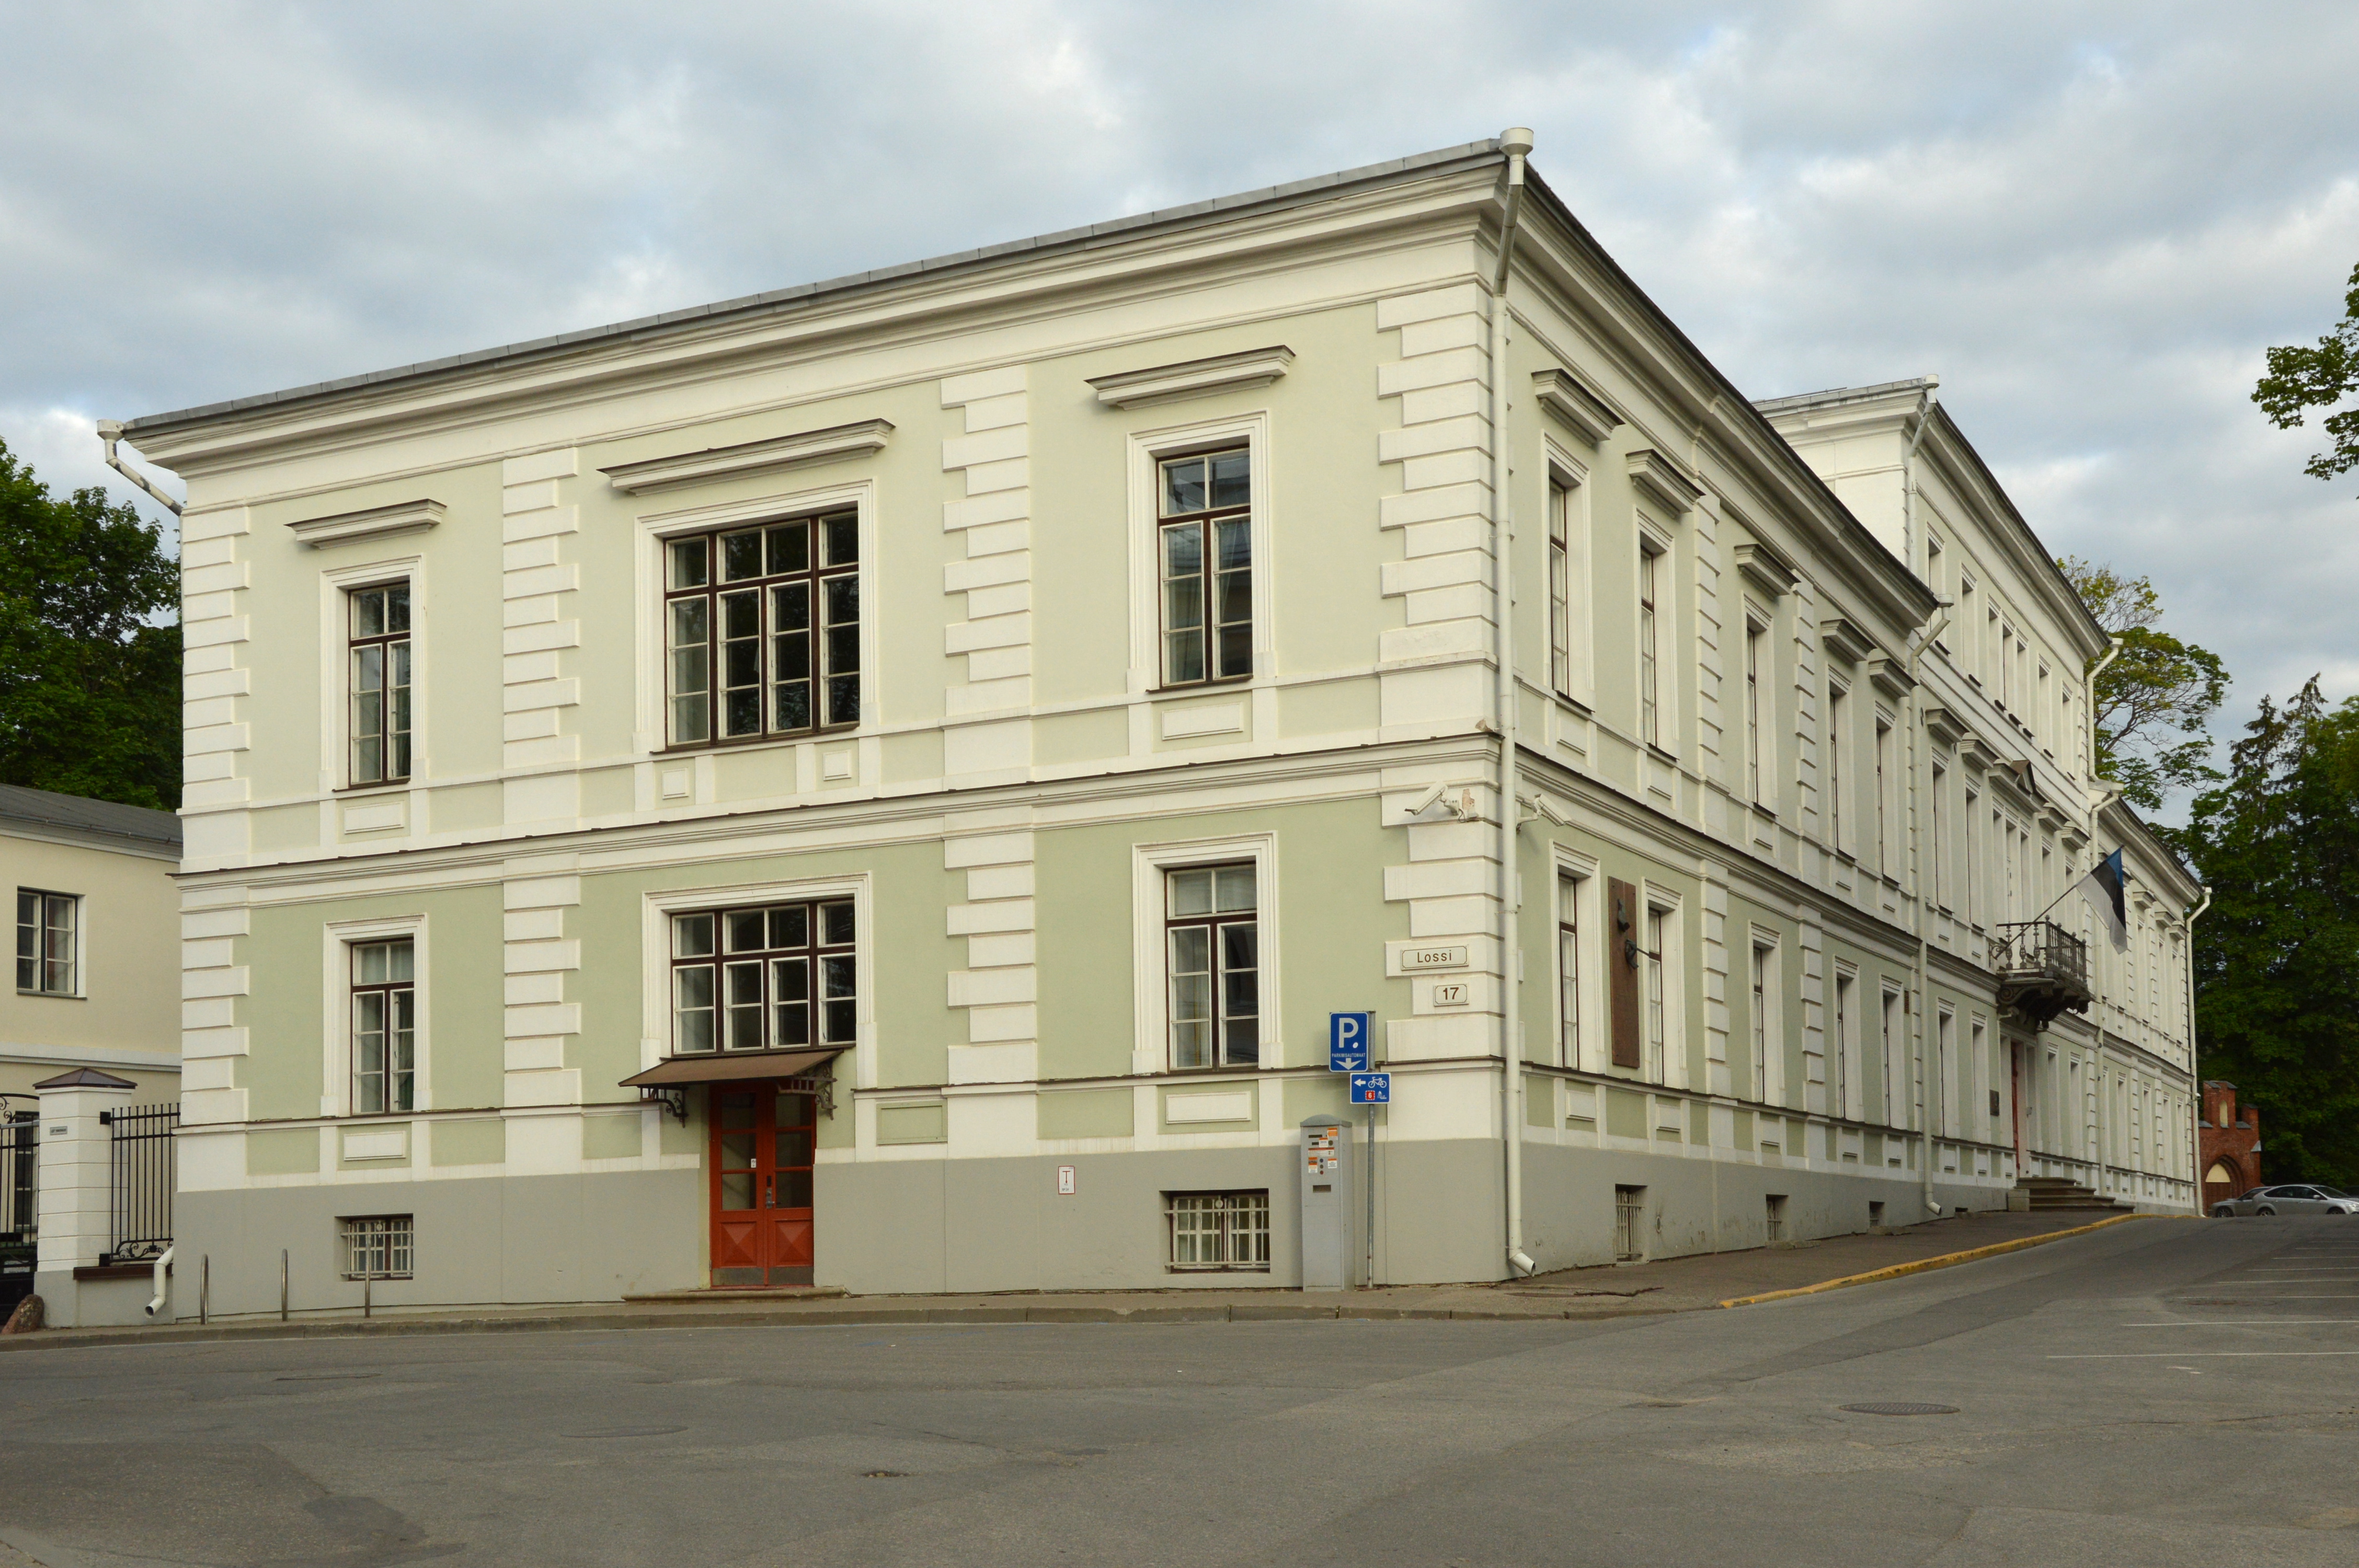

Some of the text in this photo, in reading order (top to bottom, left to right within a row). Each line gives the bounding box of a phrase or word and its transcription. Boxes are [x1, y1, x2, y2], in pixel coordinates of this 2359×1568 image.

[1417, 950, 1451, 963] Lossi
[1443, 987, 1459, 1000] 17
[1339, 1018, 1359, 1048] P
